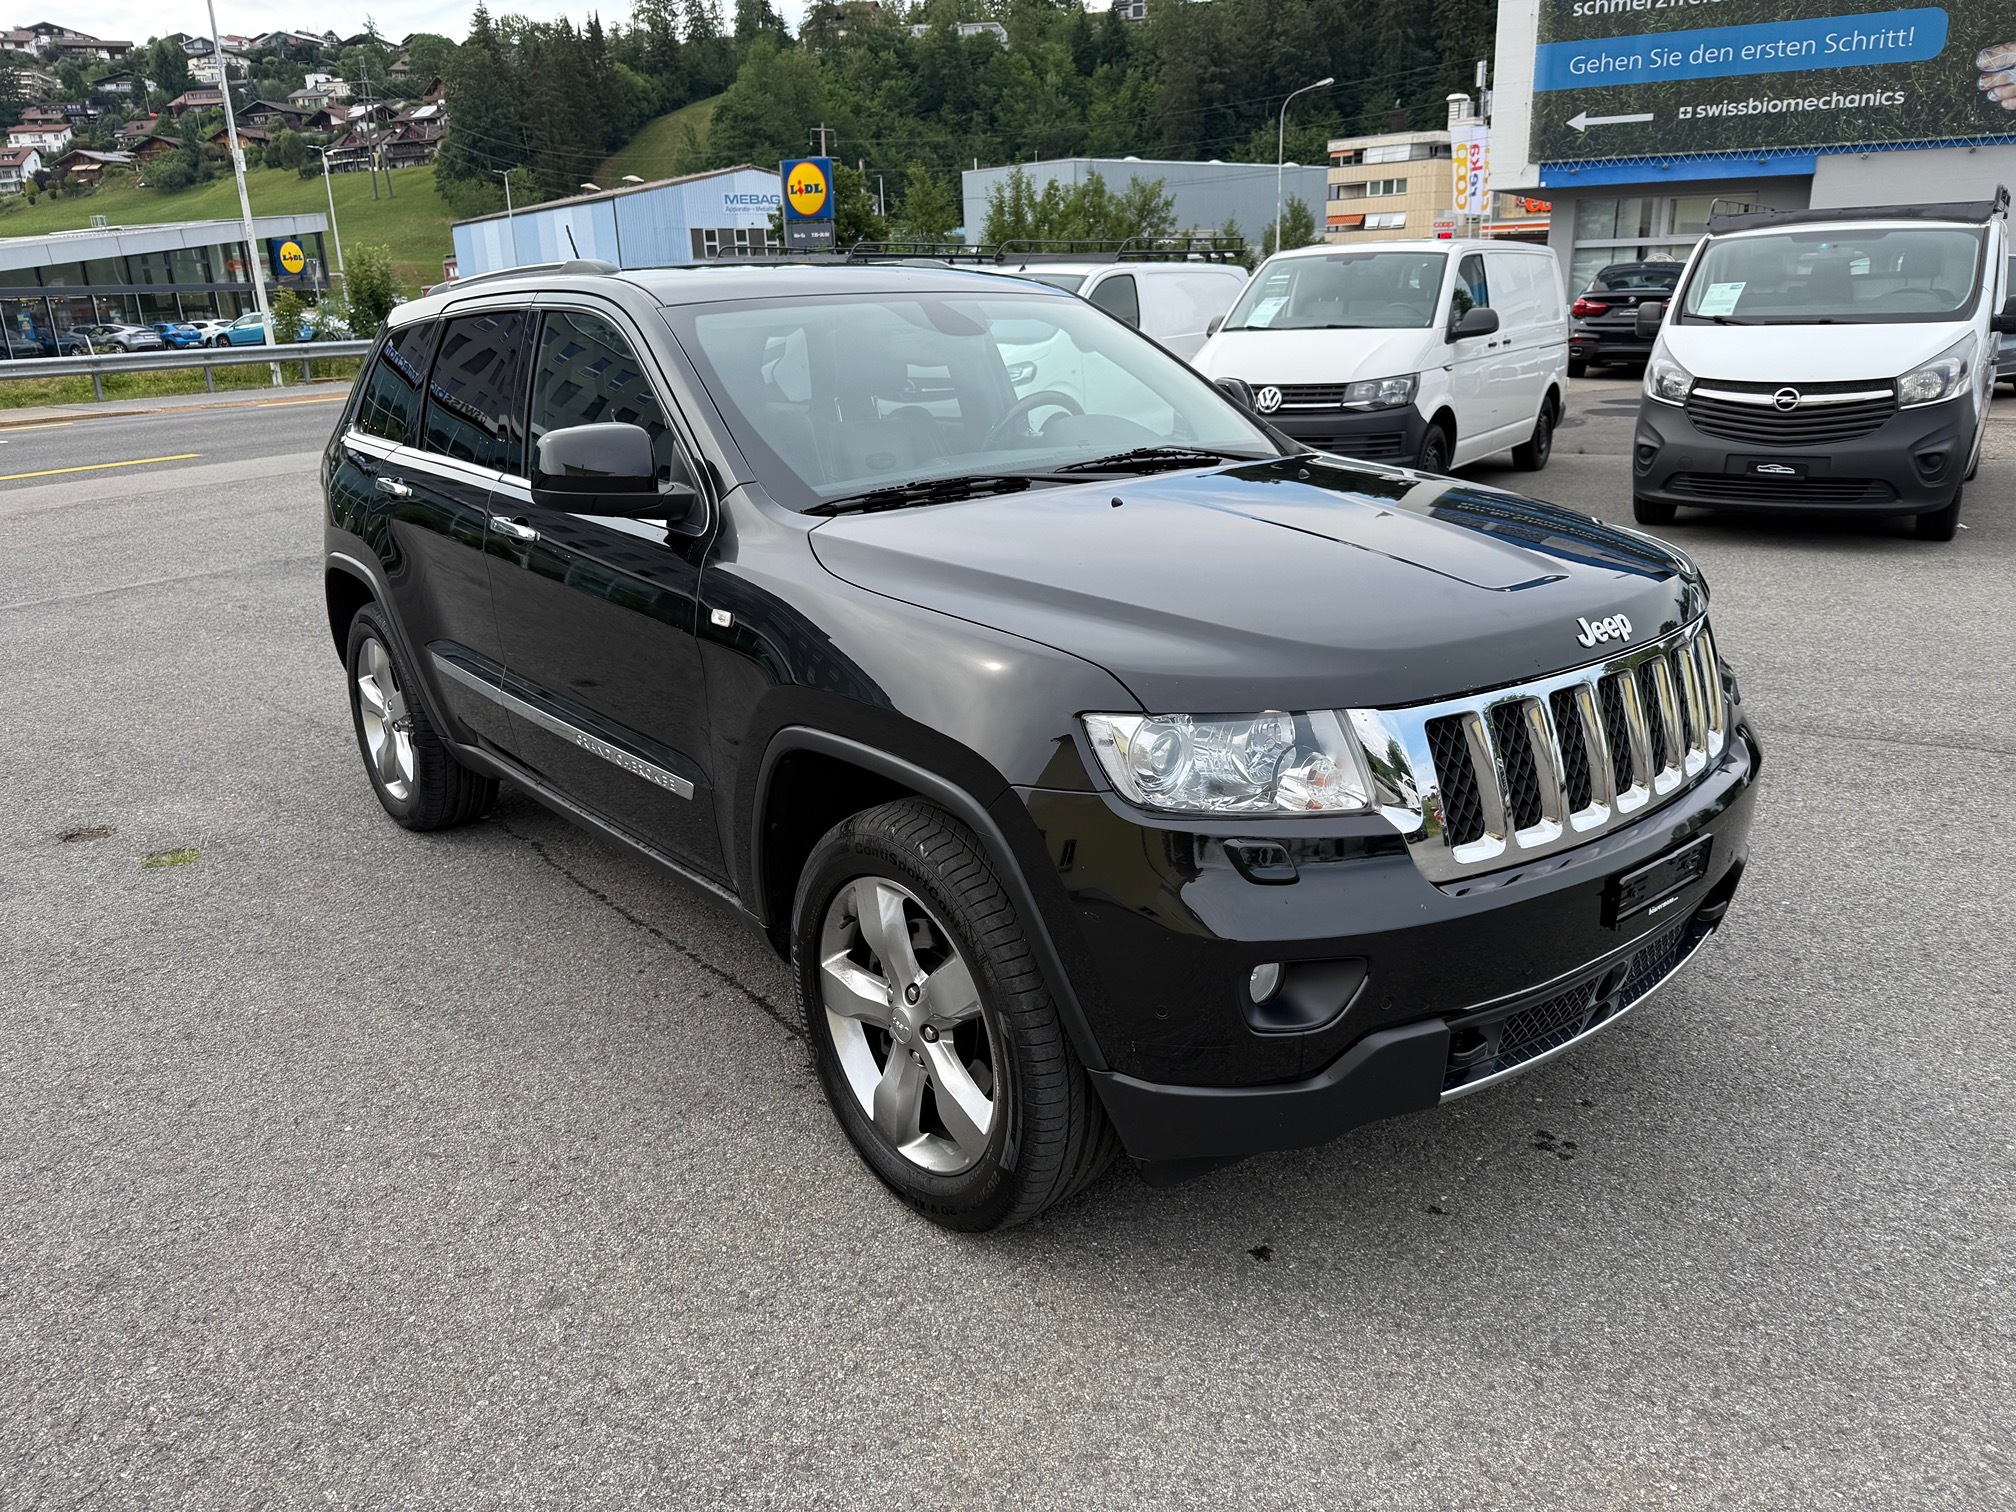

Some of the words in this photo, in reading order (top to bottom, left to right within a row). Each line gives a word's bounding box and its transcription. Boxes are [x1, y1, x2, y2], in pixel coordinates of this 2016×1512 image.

[1569, 52, 1642, 75] Gehen
[1649, 48, 1682, 68] Sie
[1689, 44, 1733, 65] den
[1741, 39, 1816, 60] ersten
[1824, 26, 1915, 54] Schritt!
[1696, 88, 1905, 118] swissbiomechanics
[724, 194, 781, 204] MEBAG
[1576, 613, 1632, 648] Jeep
[576, 734, 611, 759] GRAND
[615, 754, 677, 792] CHEROKEE
